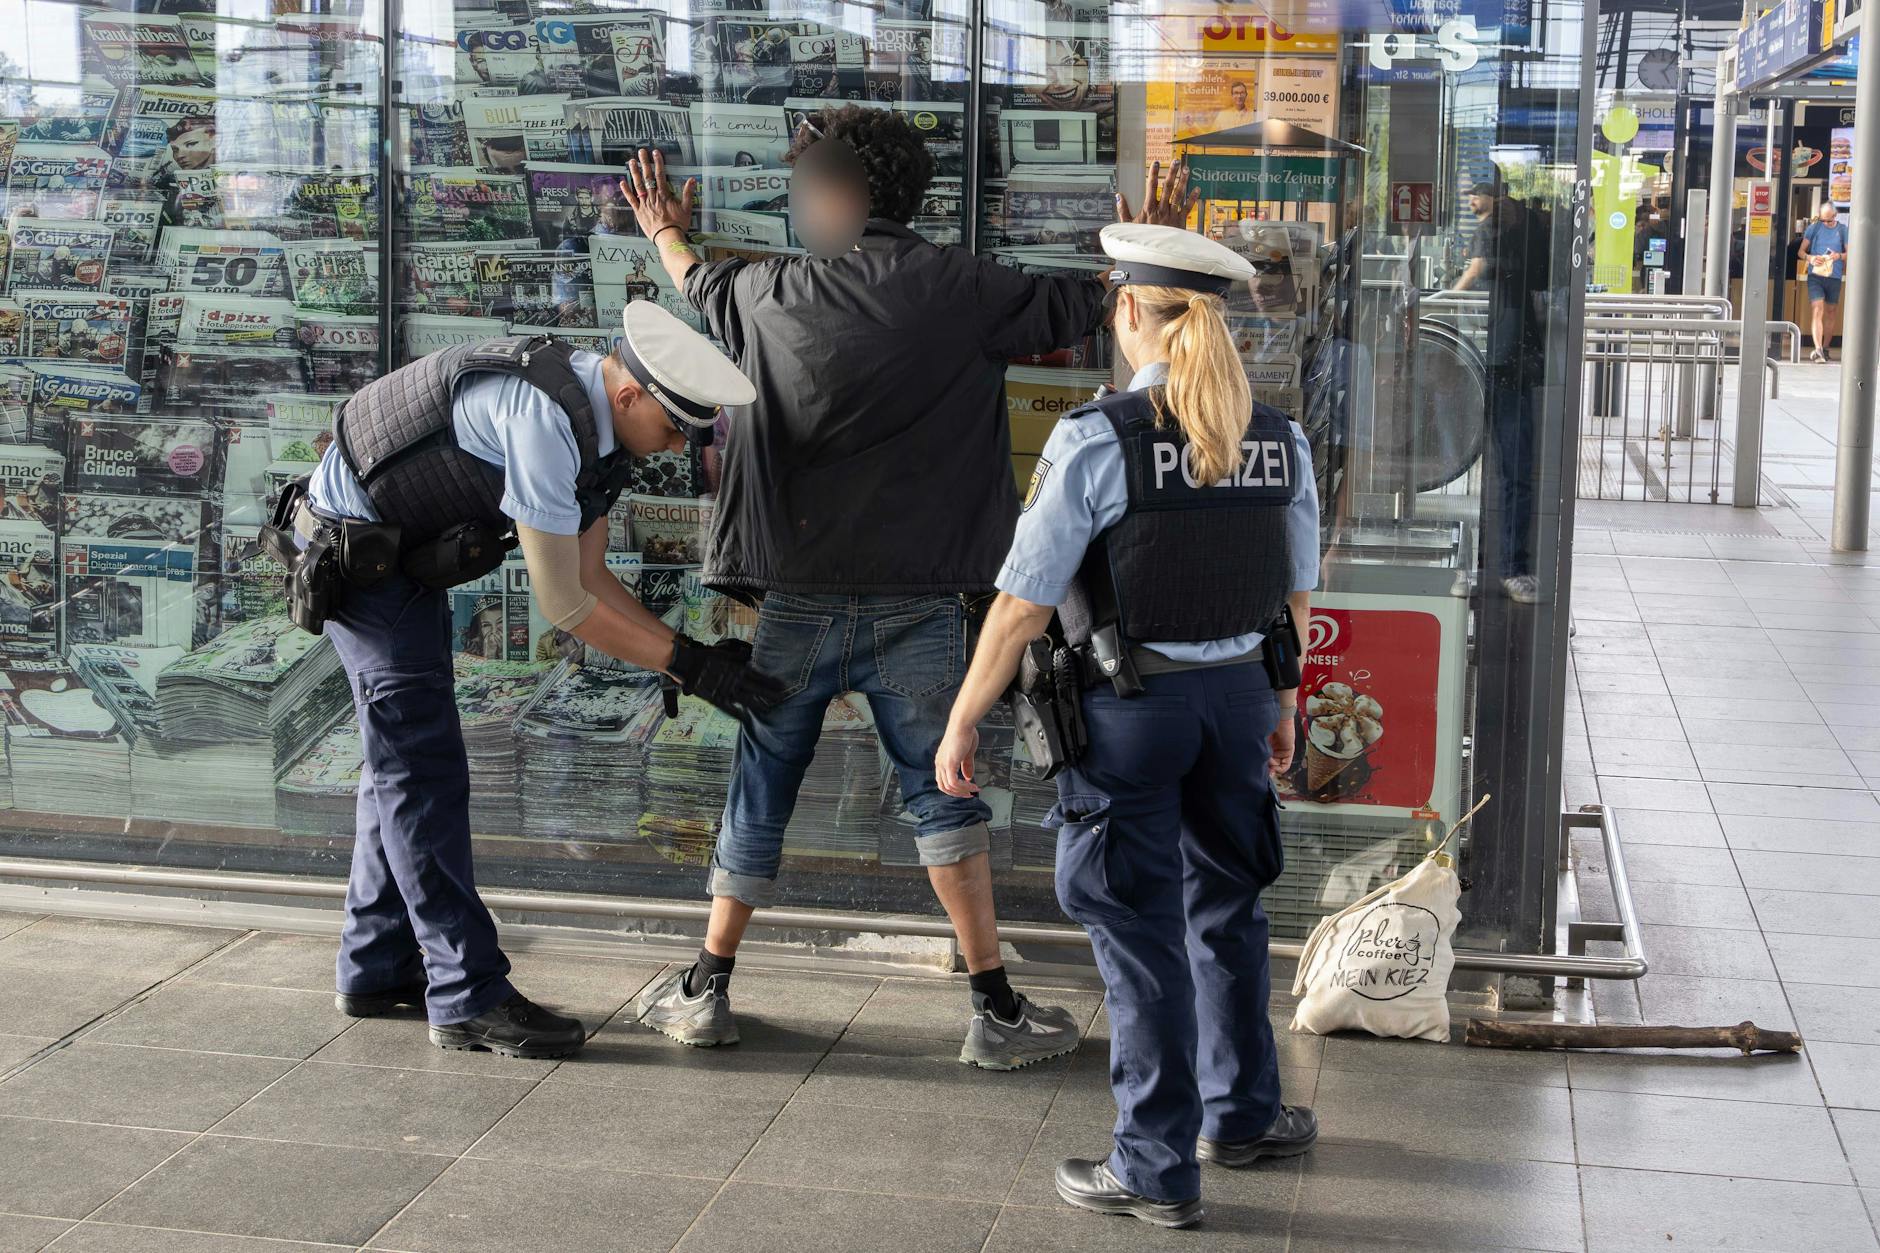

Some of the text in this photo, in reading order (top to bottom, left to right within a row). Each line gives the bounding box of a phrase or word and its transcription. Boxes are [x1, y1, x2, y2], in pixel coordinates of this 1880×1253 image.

[1264, 91, 1330, 104] 39.000.000 €
[523, 119, 547, 128] THE
[1191, 167, 1337, 189] Süddeutsche Zeitung
[541, 187, 569, 197] PRESS
[104, 212, 155, 224] FOTOS
[191, 256, 258, 286] 50
[85, 444, 135, 461] Bruce
[83, 460, 137, 478] Gilden
[1153, 440, 1290, 490] POZEI
[91, 550, 128, 560] Spezial
[91, 560, 158, 572] Digitalkameras
[1357, 949, 1402, 961] coffee
[1329, 967, 1430, 989] MEIN KIEZ
